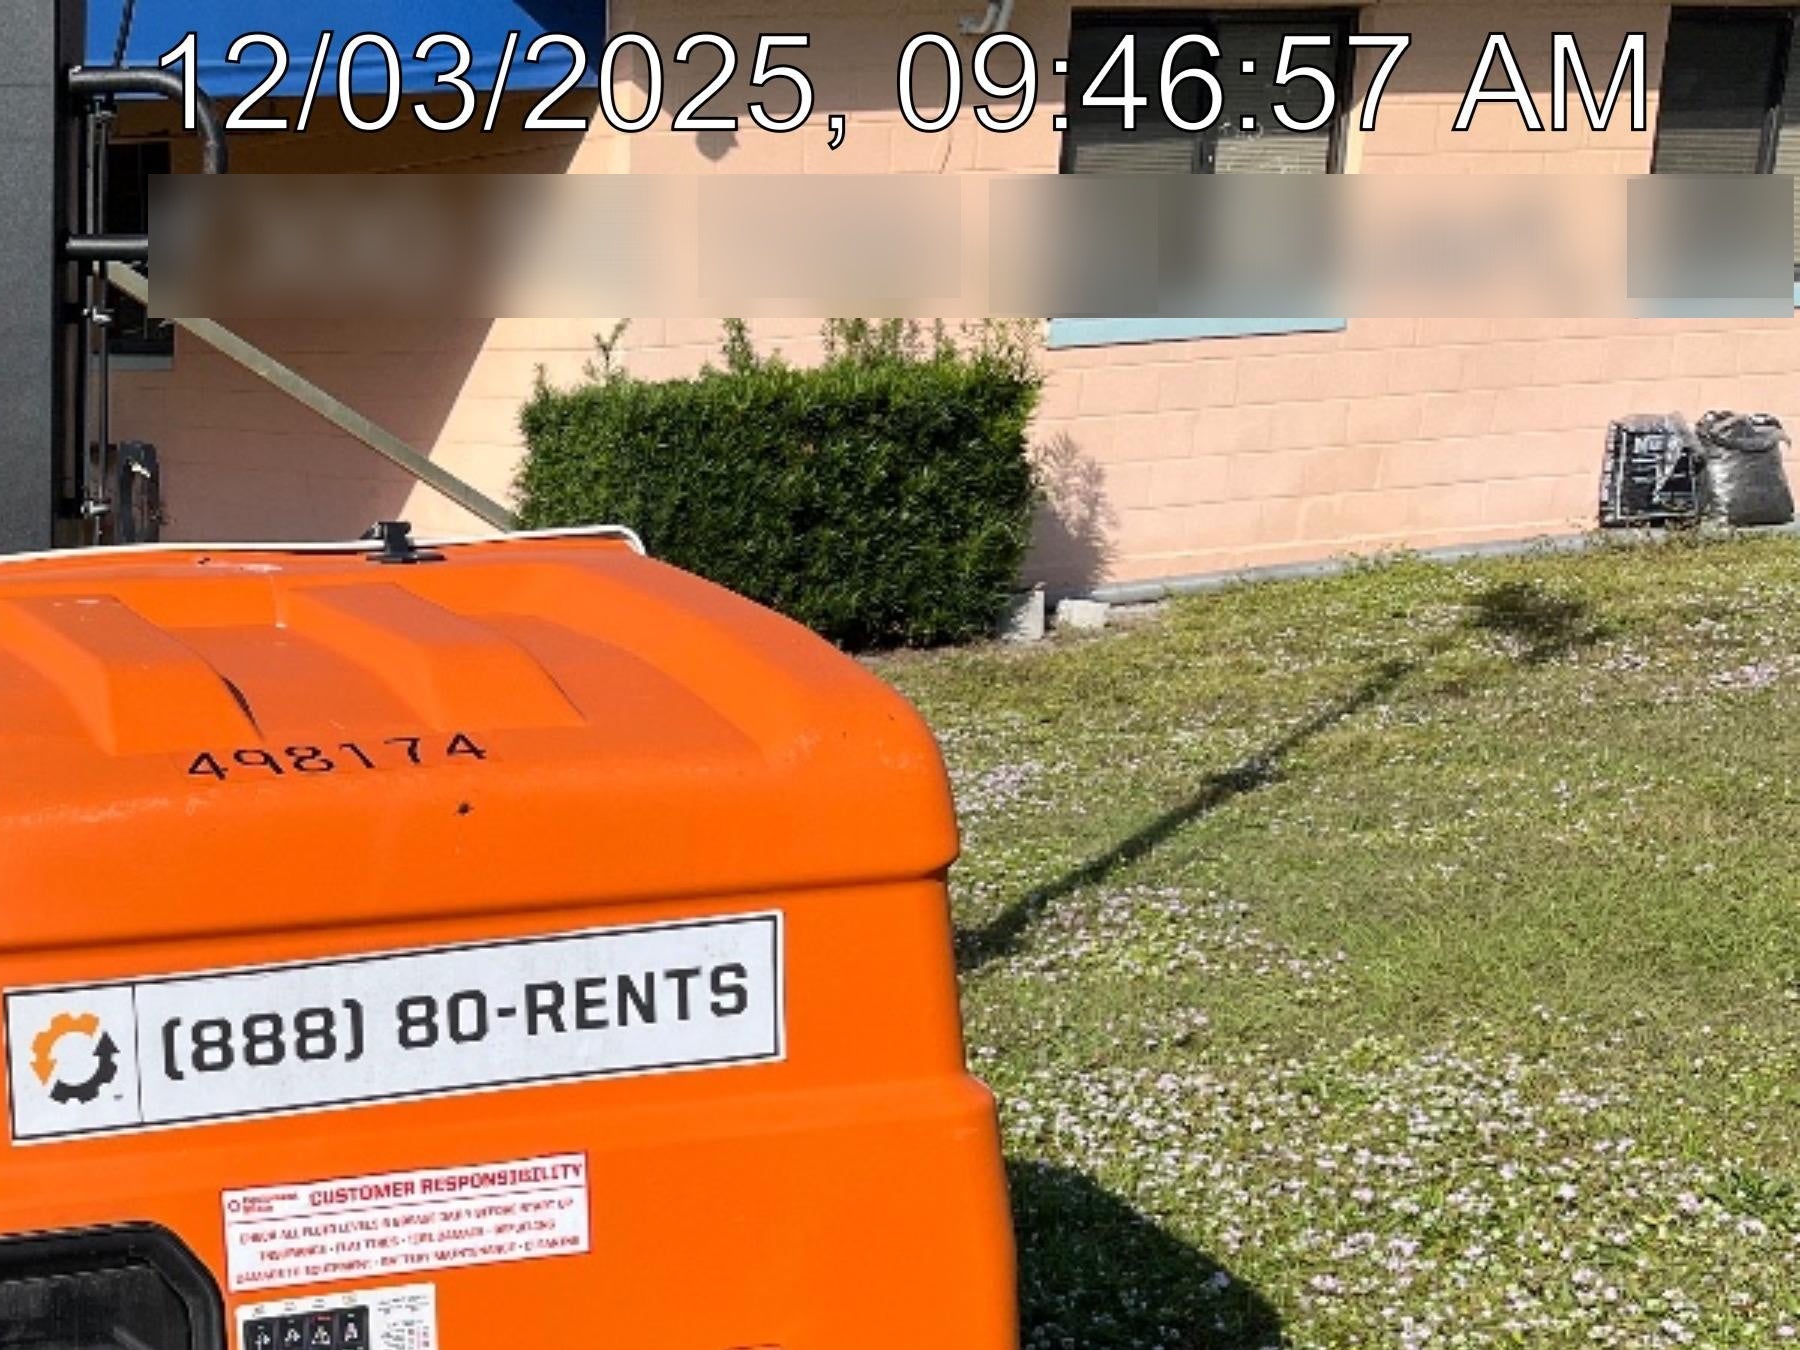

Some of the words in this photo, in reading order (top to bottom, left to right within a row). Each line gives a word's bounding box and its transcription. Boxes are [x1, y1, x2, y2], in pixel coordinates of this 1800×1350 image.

[187, 733, 487, 781] 498174
[162, 998, 365, 1082] (888)
[397, 960, 749, 1050] 80-RENTS
[308, 1180, 414, 1206] CUSTOMER
[420, 1162, 582, 1194] RESPONSIBILITY
